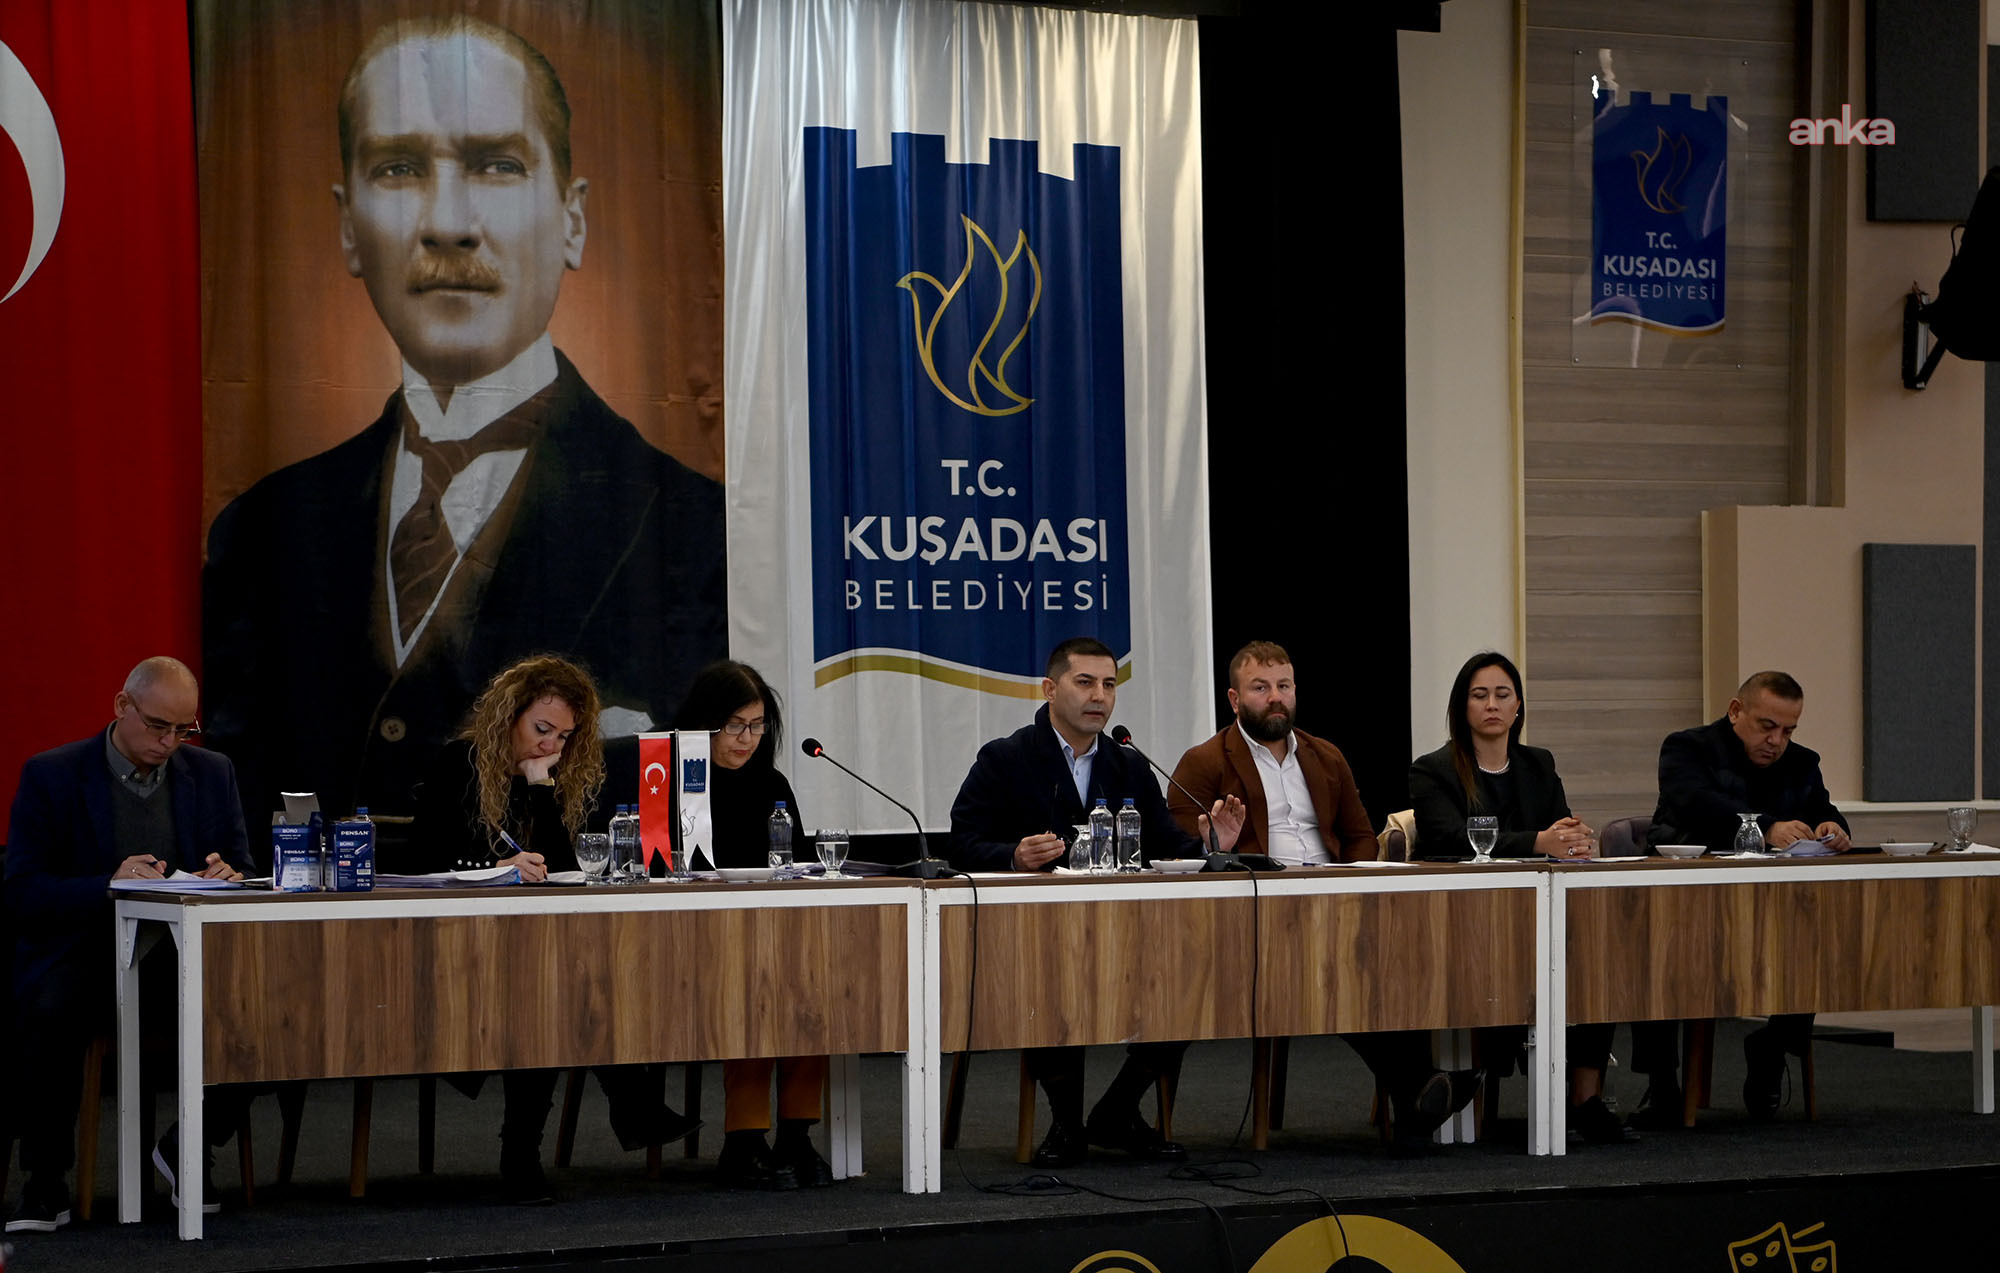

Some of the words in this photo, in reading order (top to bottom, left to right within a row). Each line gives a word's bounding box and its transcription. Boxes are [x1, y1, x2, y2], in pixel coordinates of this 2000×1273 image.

[1645, 231, 1678, 250] T.C.
[1603, 254, 1717, 279] KUŞADASI
[1602, 281, 1716, 301] BELEDİYESİ
[940, 458, 1018, 498] T.C.
[843, 514, 1109, 567] KUŞADASI
[845, 572, 1109, 612] BELEDİYESİ
